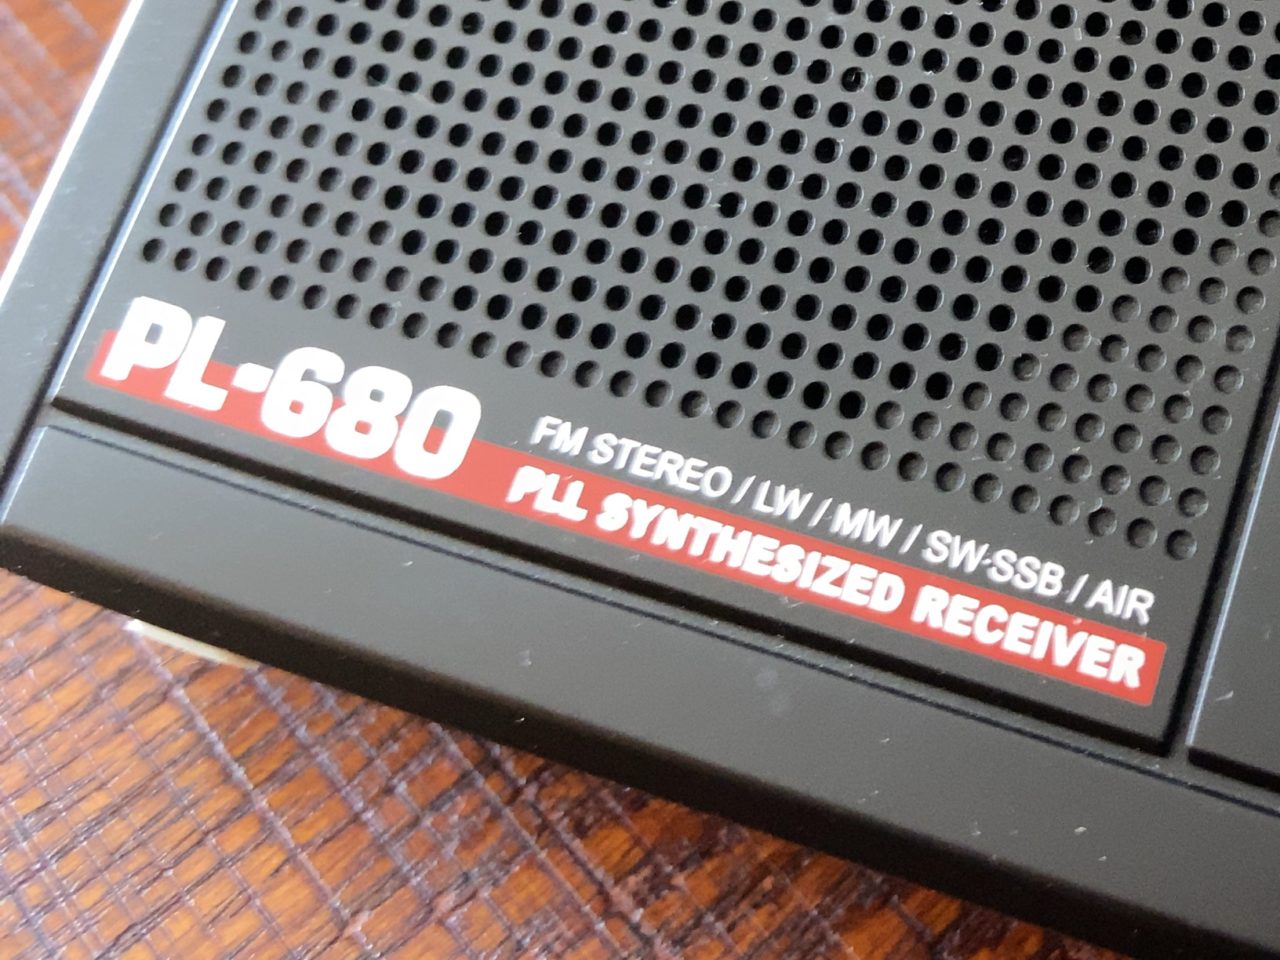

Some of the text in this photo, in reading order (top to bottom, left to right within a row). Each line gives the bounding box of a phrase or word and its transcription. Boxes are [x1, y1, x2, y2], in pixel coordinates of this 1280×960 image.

[102, 295, 482, 482] PL-680
[505, 465, 1147, 689] PLL SYNTHESIZED RECEIVER
[529, 416, 590, 457] FM
[587, 432, 734, 498] STEREO
[1084, 579, 1156, 626] AIR
